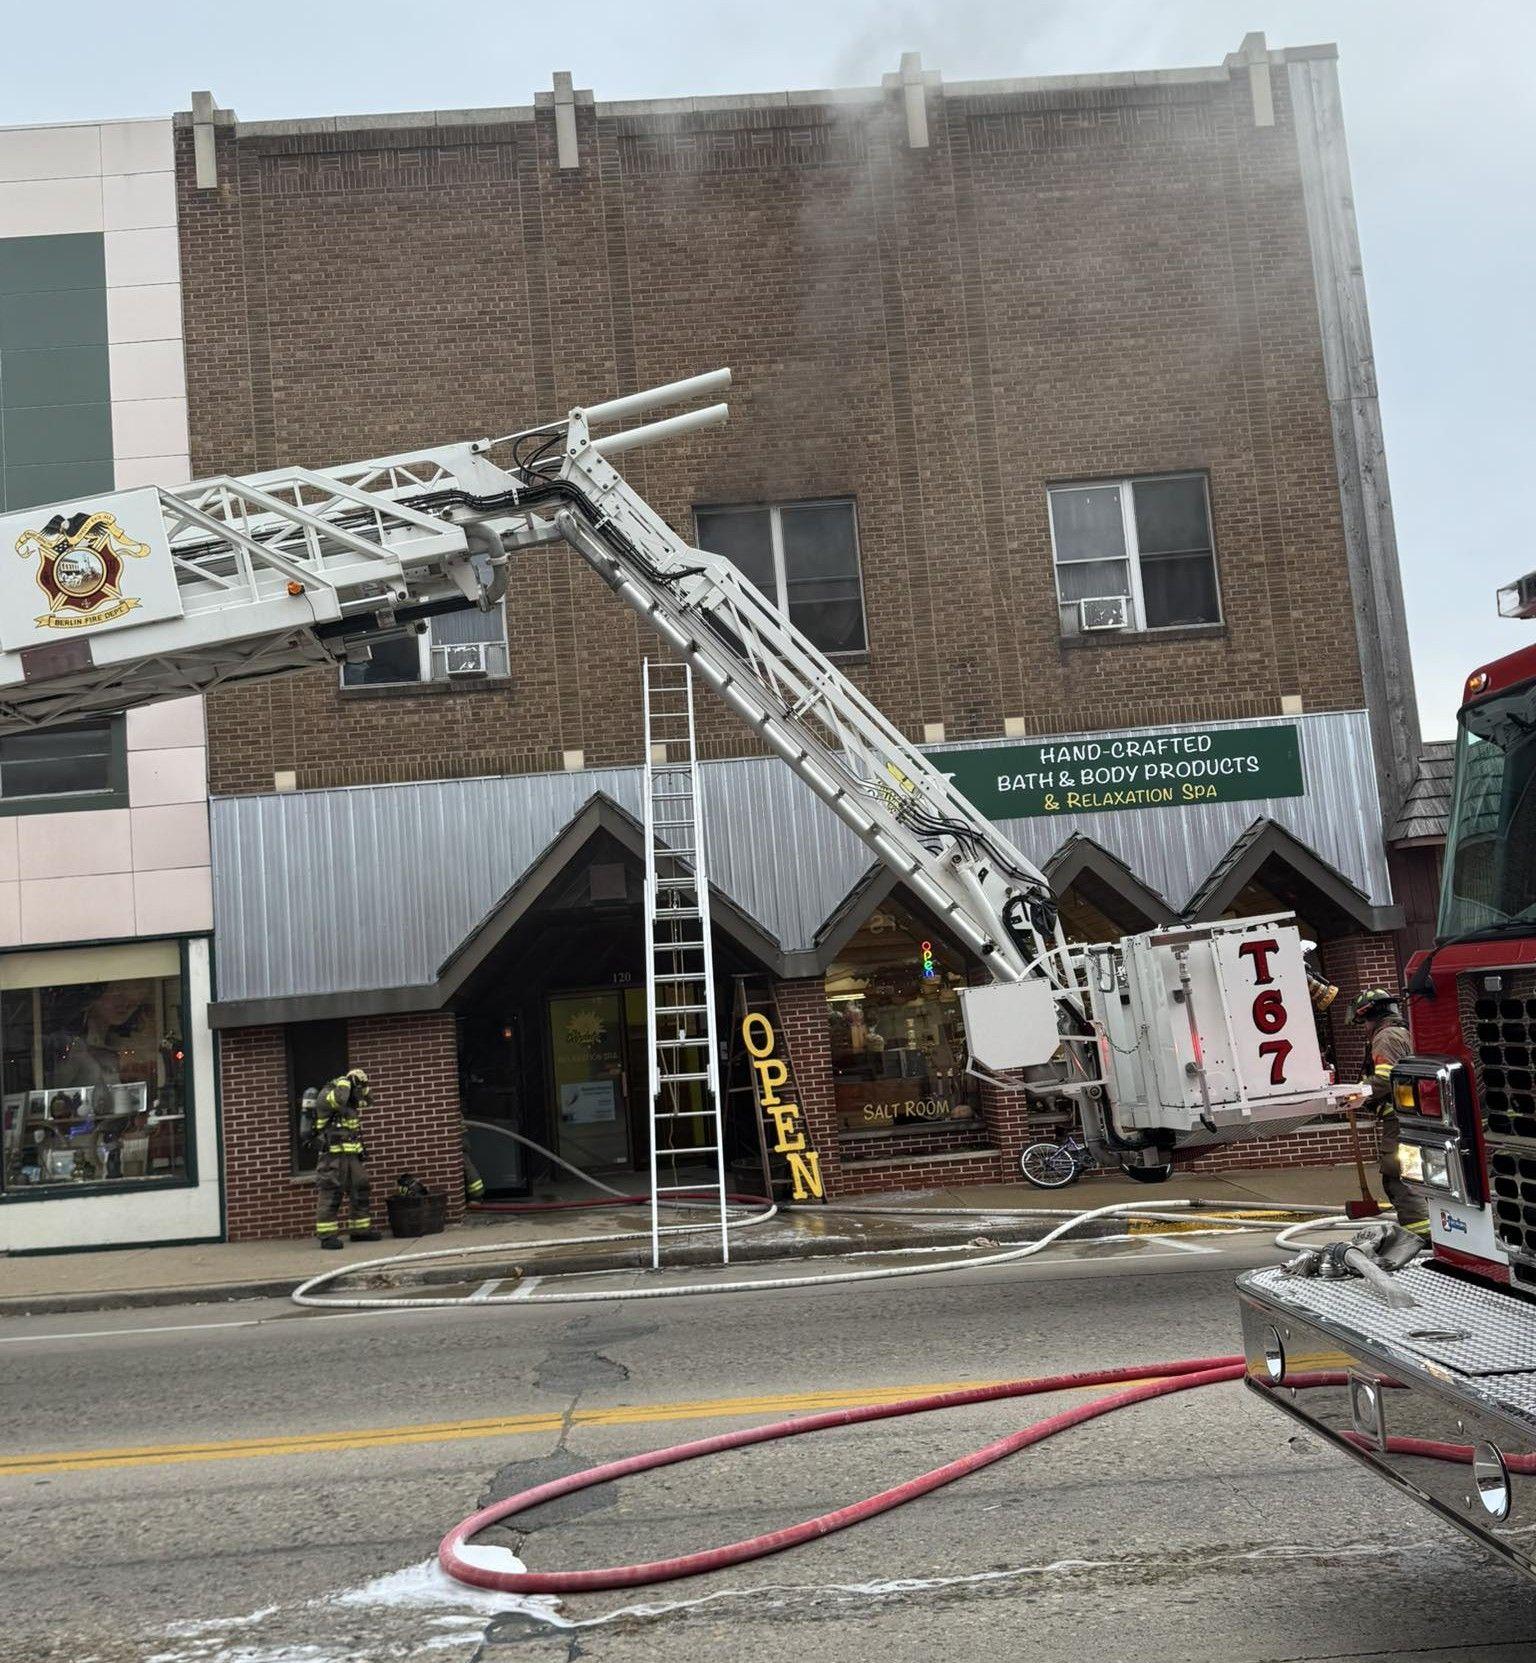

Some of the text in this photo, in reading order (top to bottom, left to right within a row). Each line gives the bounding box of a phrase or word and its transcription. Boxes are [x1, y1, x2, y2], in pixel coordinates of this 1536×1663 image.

[54, 617, 82, 627] BERLIN
[84, 613, 103, 624] FIRE
[1040, 735, 1212, 764] HAND-CRAFTED
[997, 755, 1260, 792] BATH & BODY PRODUCTS
[1044, 793, 1061, 810] &
[1066, 787, 1174, 808] RELAXATION
[612, 972, 632, 983] 120
[742, 1012, 823, 1200] OPEN
[863, 1100, 950, 1120] SALT ROOM
